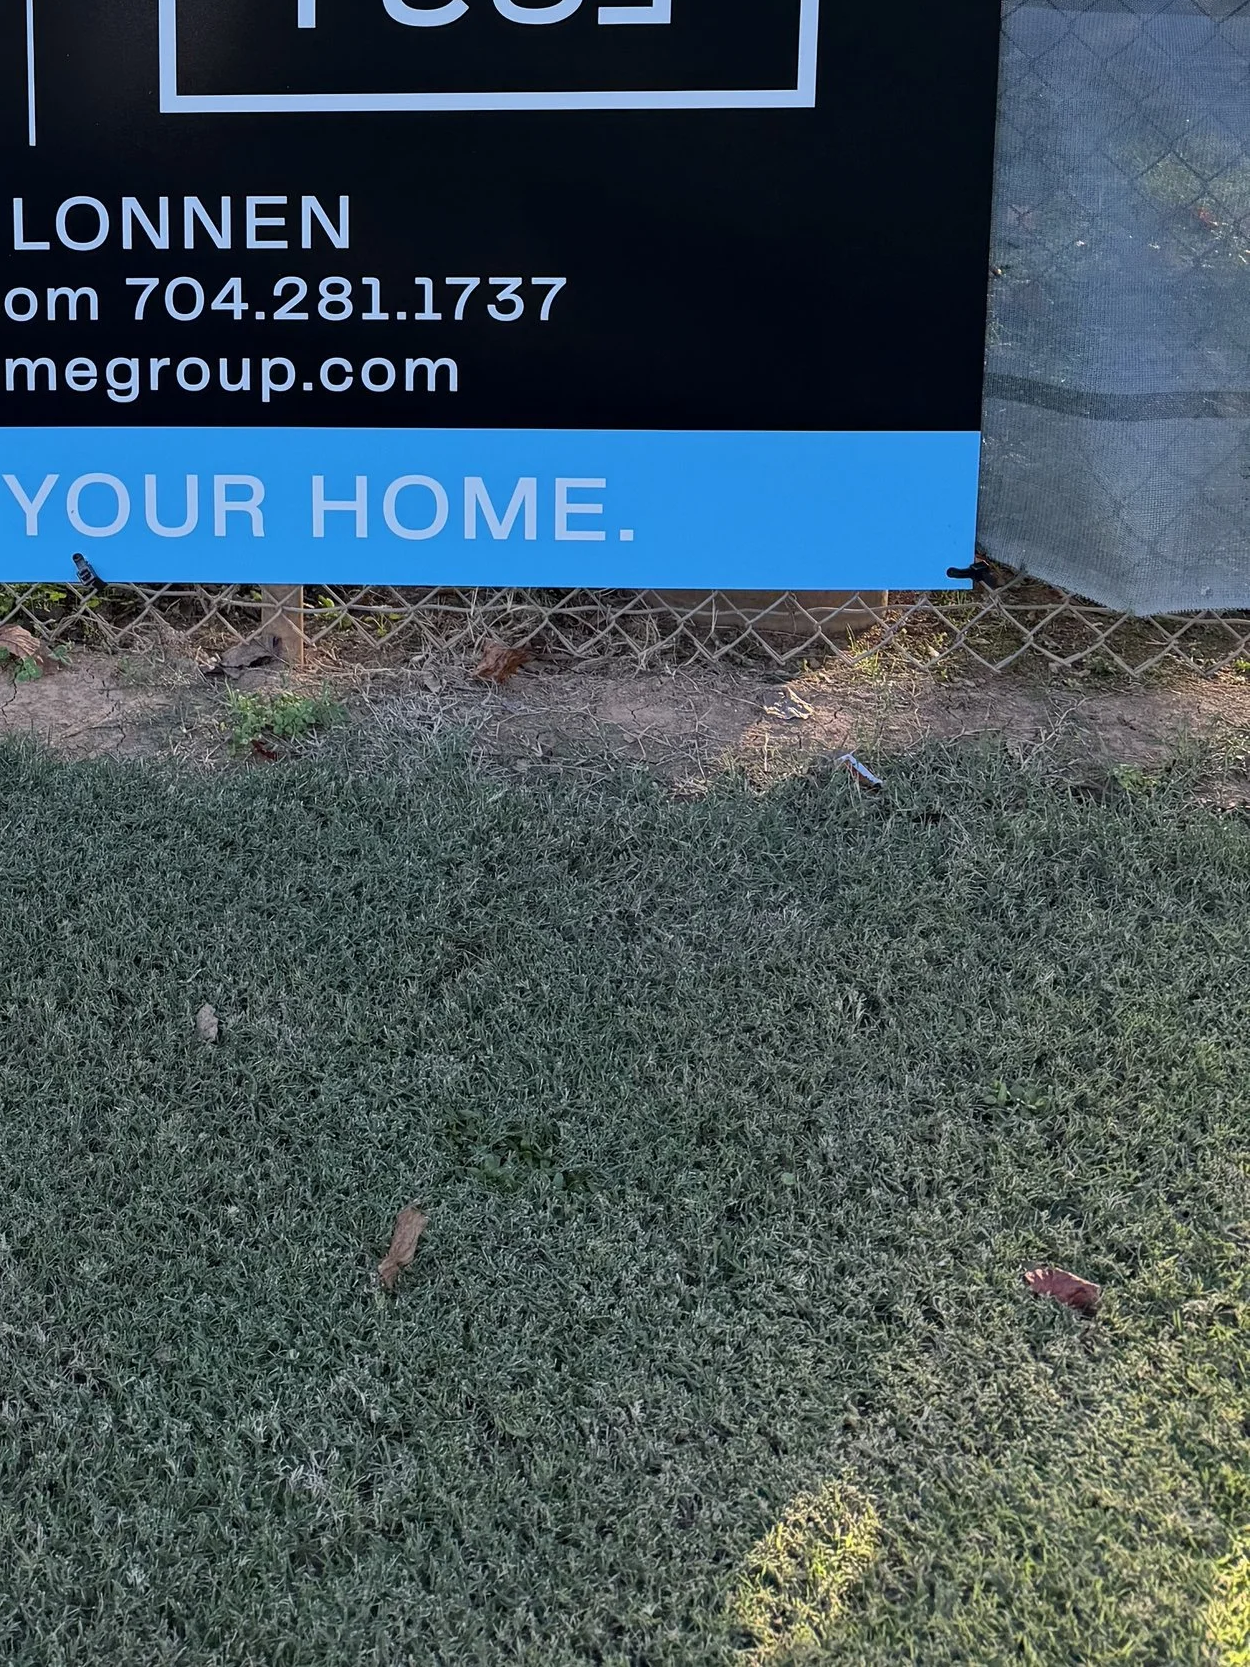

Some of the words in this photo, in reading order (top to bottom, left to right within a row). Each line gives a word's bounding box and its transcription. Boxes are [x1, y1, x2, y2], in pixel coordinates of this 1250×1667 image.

[12, 195, 350, 251] LONNEN
[125, 276, 567, 322] 704.281.1737
[2, 472, 265, 538] YOUR
[312, 474, 634, 541] HOME.
